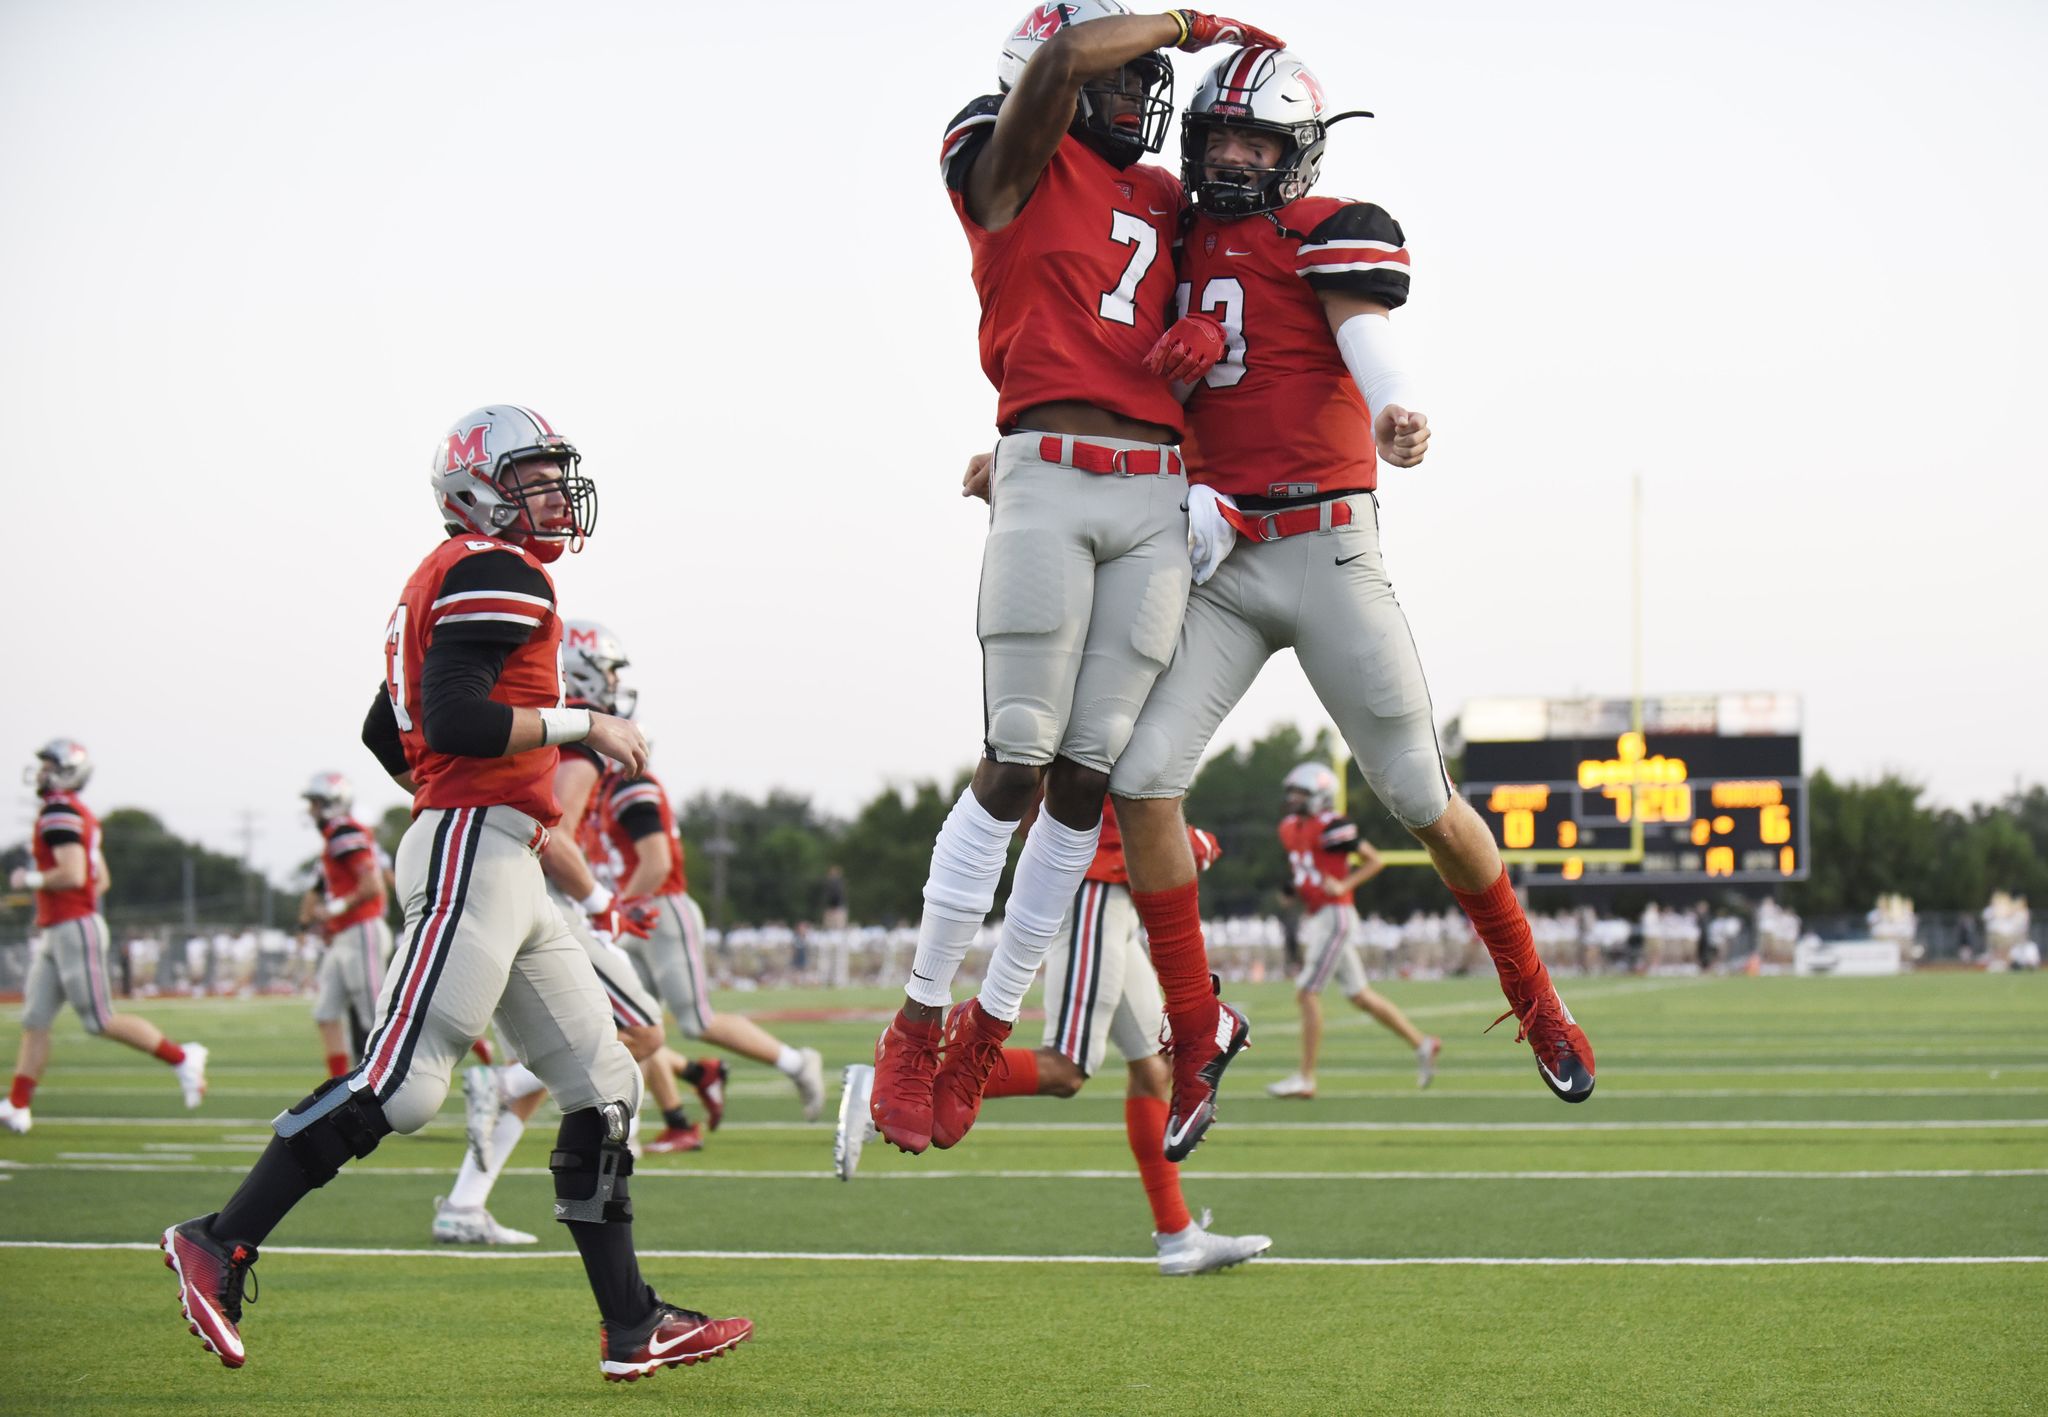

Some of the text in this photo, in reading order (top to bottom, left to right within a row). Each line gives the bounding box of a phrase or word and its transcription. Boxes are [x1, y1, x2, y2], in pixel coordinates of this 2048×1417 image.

[1098, 207, 1159, 327] 7
[443, 422, 493, 477] M
[567, 627, 598, 651] M
[1503, 809, 1535, 849] 0
[1760, 804, 1791, 844] 6
[1214, 1003, 1235, 1055] NIKE
